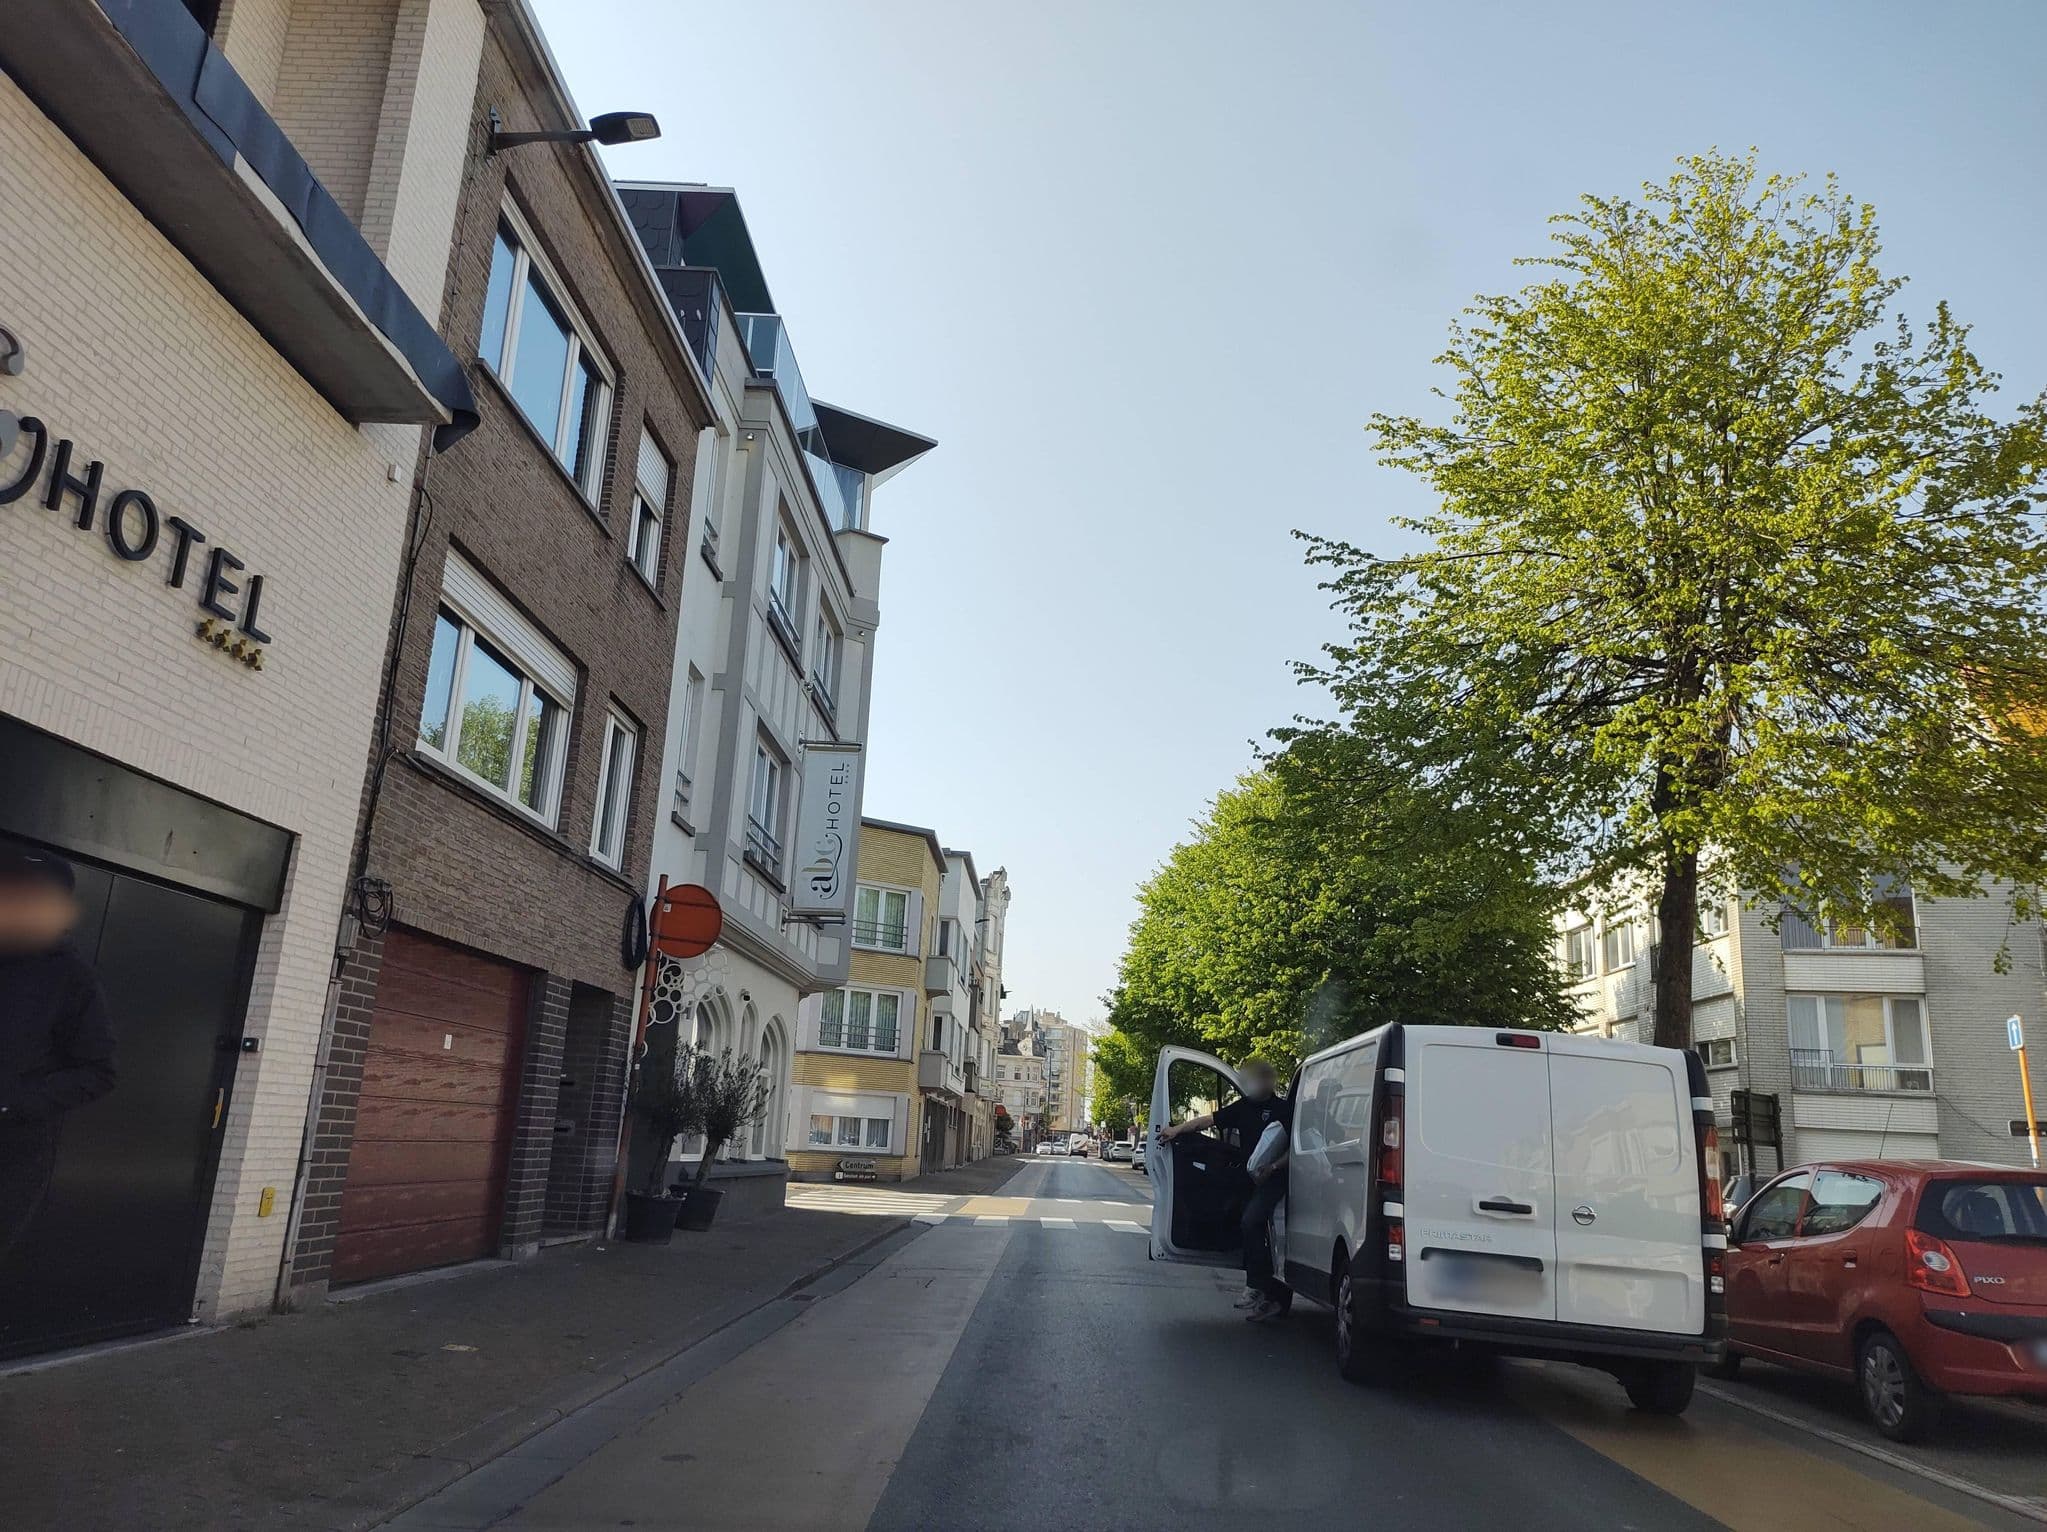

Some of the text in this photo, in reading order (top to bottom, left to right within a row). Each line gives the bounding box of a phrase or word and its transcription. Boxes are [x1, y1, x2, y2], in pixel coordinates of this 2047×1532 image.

[45, 439, 272, 644] HOTEL
[826, 763, 845, 830] HOTEL
[845, 1161, 874, 1169] Centrum
[1973, 1276, 2006, 1285] PIXO
